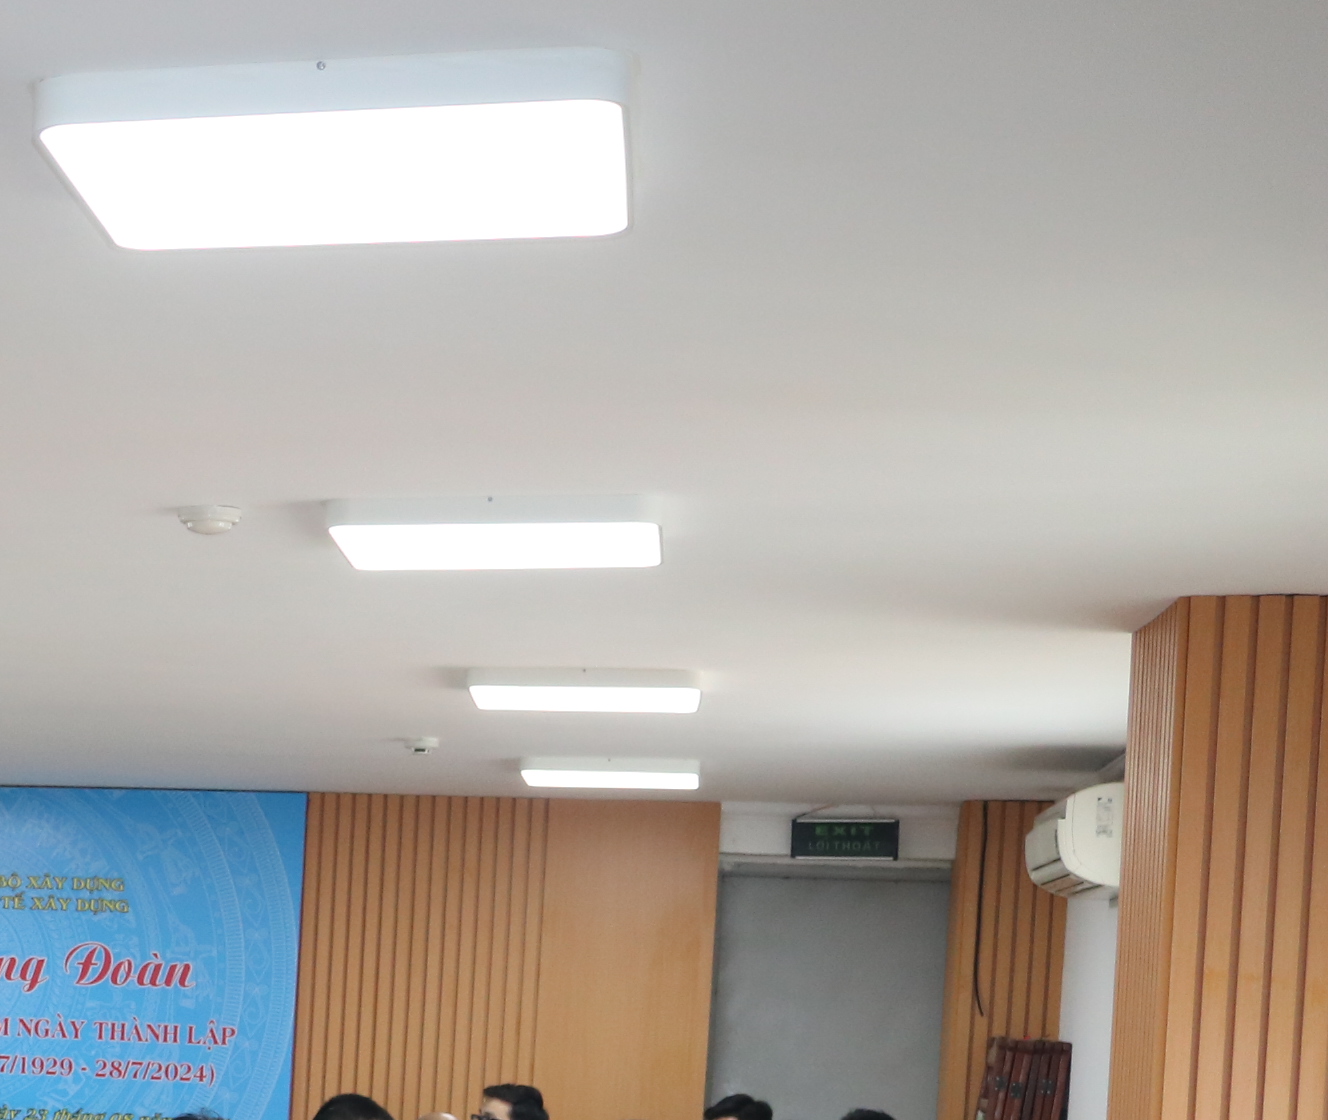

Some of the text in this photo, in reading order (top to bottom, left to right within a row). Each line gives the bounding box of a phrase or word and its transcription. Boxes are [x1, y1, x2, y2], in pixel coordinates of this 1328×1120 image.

[815, 825, 874, 836] EXIT
[26, 873, 68, 890] XÂY
[72, 876, 125, 894] DỰNG
[1, 891, 26, 910] TẾ
[31, 894, 71, 911] XÂY
[76, 897, 129, 915] DỰNG
[64, 941, 196, 988] Đoàn
[16, 1013, 87, 1040] NGÀY
[93, 1017, 180, 1045] THÀNH
[187, 1020, 237, 1050] LẬP
[95, 1060, 215, 1087] 28/7/2024)
